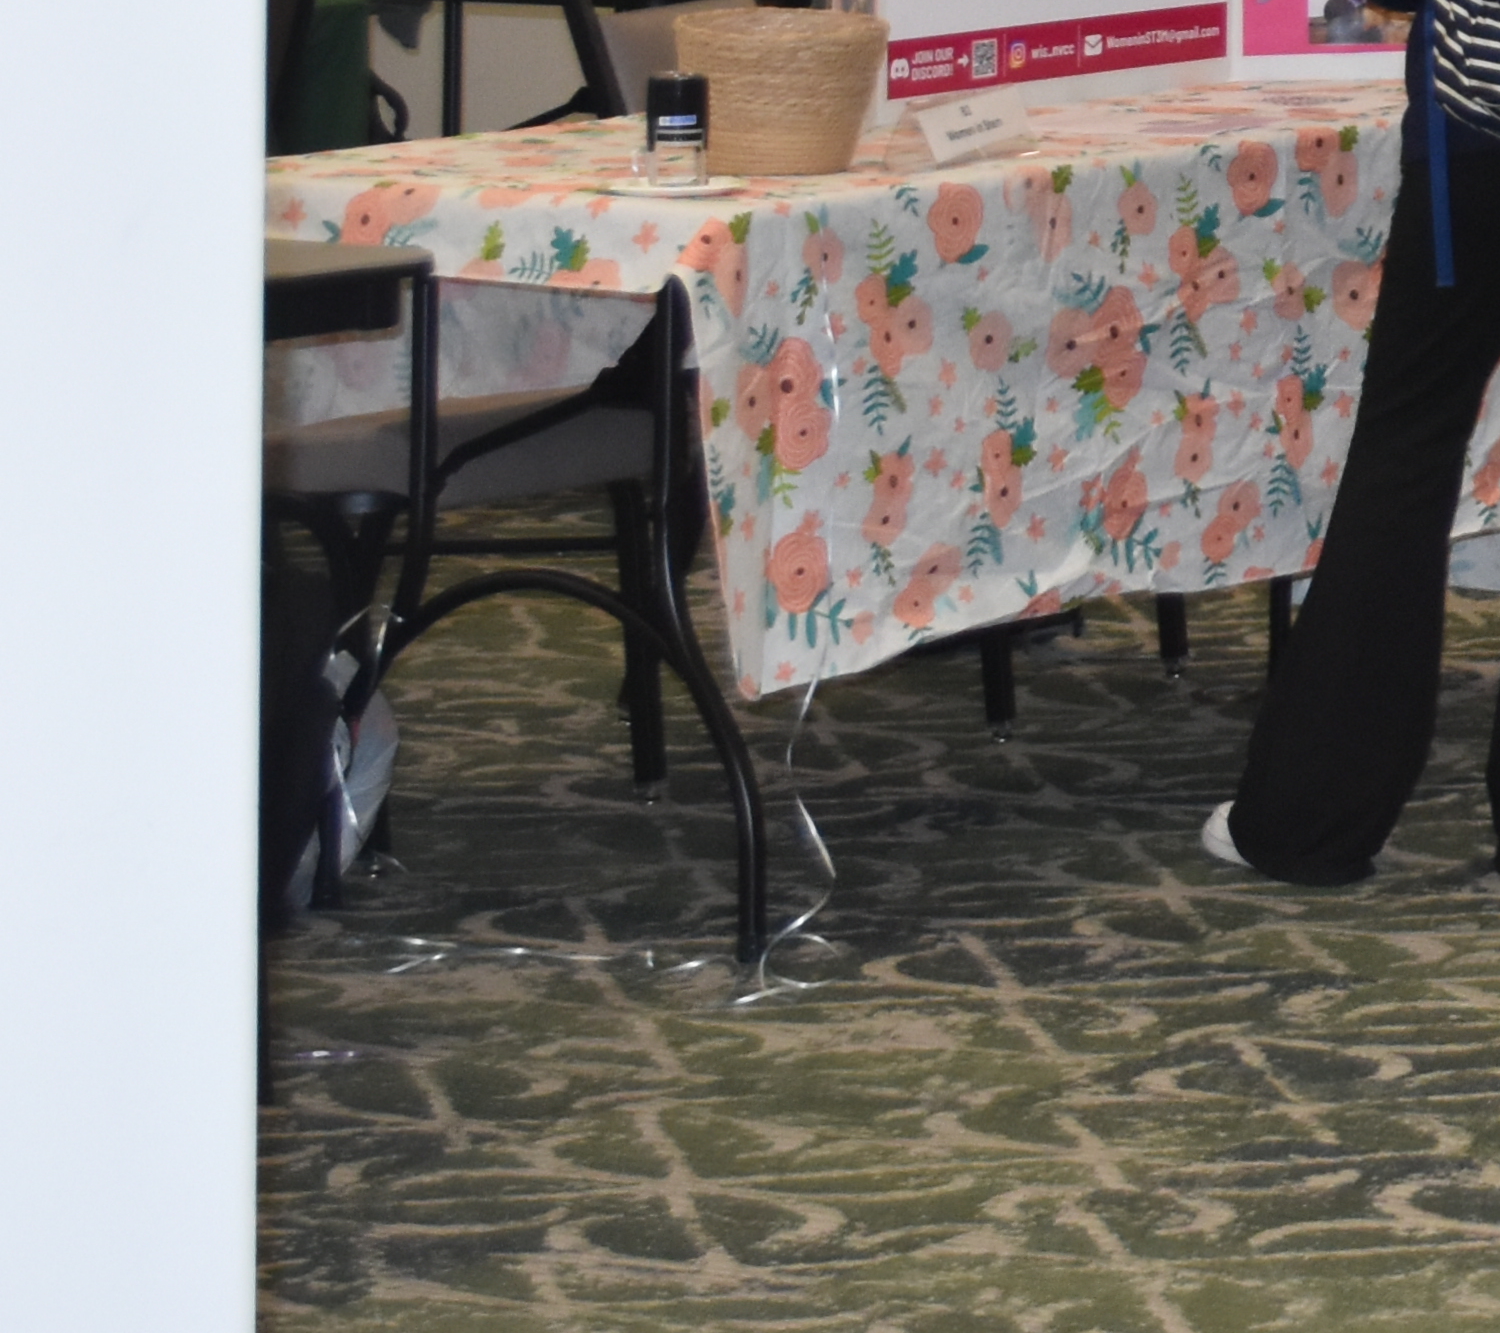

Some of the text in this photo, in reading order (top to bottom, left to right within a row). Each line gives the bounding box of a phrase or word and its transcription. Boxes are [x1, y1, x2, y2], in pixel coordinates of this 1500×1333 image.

[912, 47, 954, 65] JOIN OUR
[911, 64, 954, 81] DISCORD!
